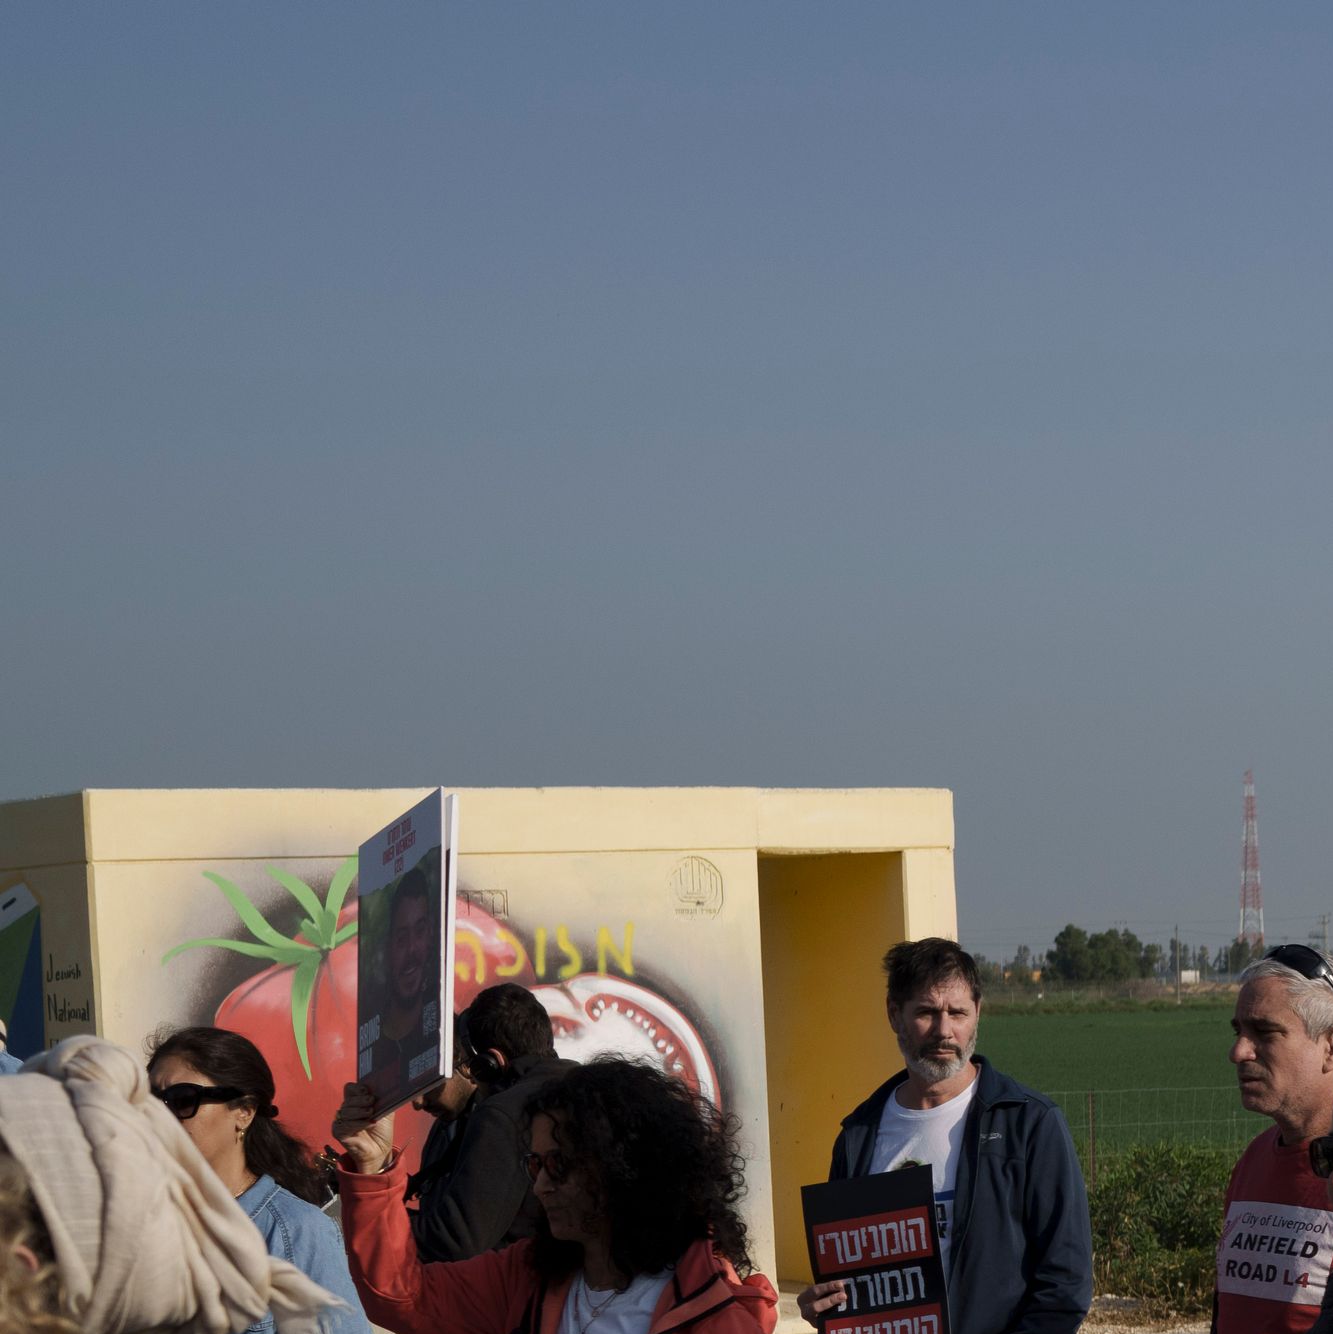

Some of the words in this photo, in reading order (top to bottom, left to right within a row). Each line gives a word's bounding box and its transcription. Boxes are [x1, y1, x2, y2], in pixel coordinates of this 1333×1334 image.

[46, 953, 81, 982] Jewish
[47, 993, 90, 1022] National
[1241, 1212, 1260, 1229] City
[1260, 1214, 1273, 1226] of
[1272, 1215, 1328, 1234] Liverpool
[817, 1216, 928, 1265] הומניטרי
[1230, 1232, 1319, 1259] ANFIELD
[1225, 1259, 1277, 1283] ROAD
[1283, 1269, 1310, 1288] L4
[838, 1265, 927, 1313] תמורת
